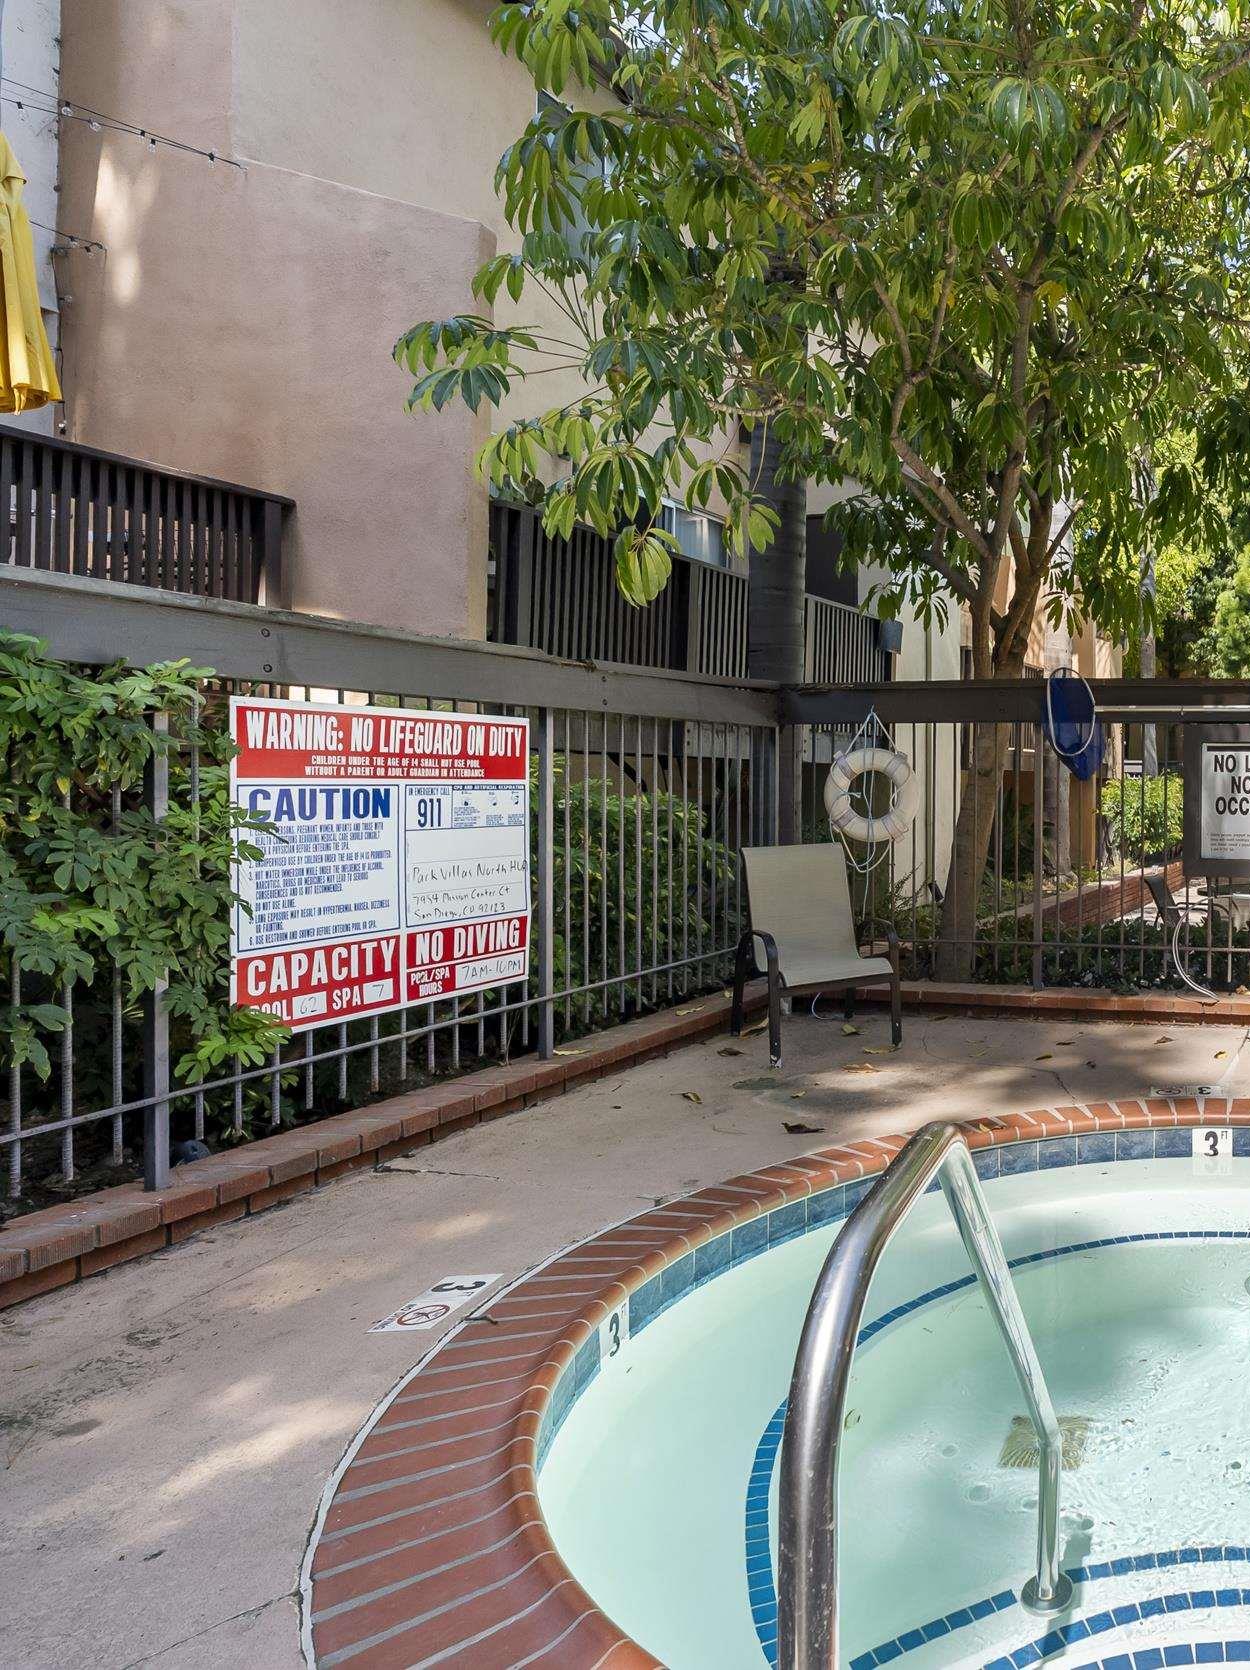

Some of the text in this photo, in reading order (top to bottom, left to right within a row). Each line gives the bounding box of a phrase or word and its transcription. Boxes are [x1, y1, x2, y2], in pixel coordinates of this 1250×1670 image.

[246, 711, 522, 757] WARNING: NO LIFEGUARD ON DUTY
[305, 766, 485, 778] WITHOUT A PARENT OR ADULT GUARDIAN IN ATTENDANCE
[312, 755, 346, 765] CHILDREN
[349, 756, 370, 766] UNDER
[373, 757, 385, 766] THE
[388, 757, 399, 766] AGE
[402, 758, 409, 766] OF
[412, 758, 418, 766] 14
[420, 758, 439, 767] SHALL
[441, 759, 452, 768] NOT
[455, 759, 465, 768] USE
[1214, 754, 1236, 773] NO
[249, 788, 390, 822] CAUTION
[418, 798, 441, 827] 911
[476, 862, 507, 877] North
[416, 919, 520, 965] NO DIVING
[247, 939, 396, 997] CAPACITY
[410, 966, 450, 986] POOL/SPA
[332, 985, 362, 1010] SPA
[373, 984, 384, 997] 7
[420, 982, 443, 997] HOURS
[1204, 1131, 1229, 1157] 3 FT
[431, 1281, 486, 1292] 3
[610, 1312, 620, 1358] 3
